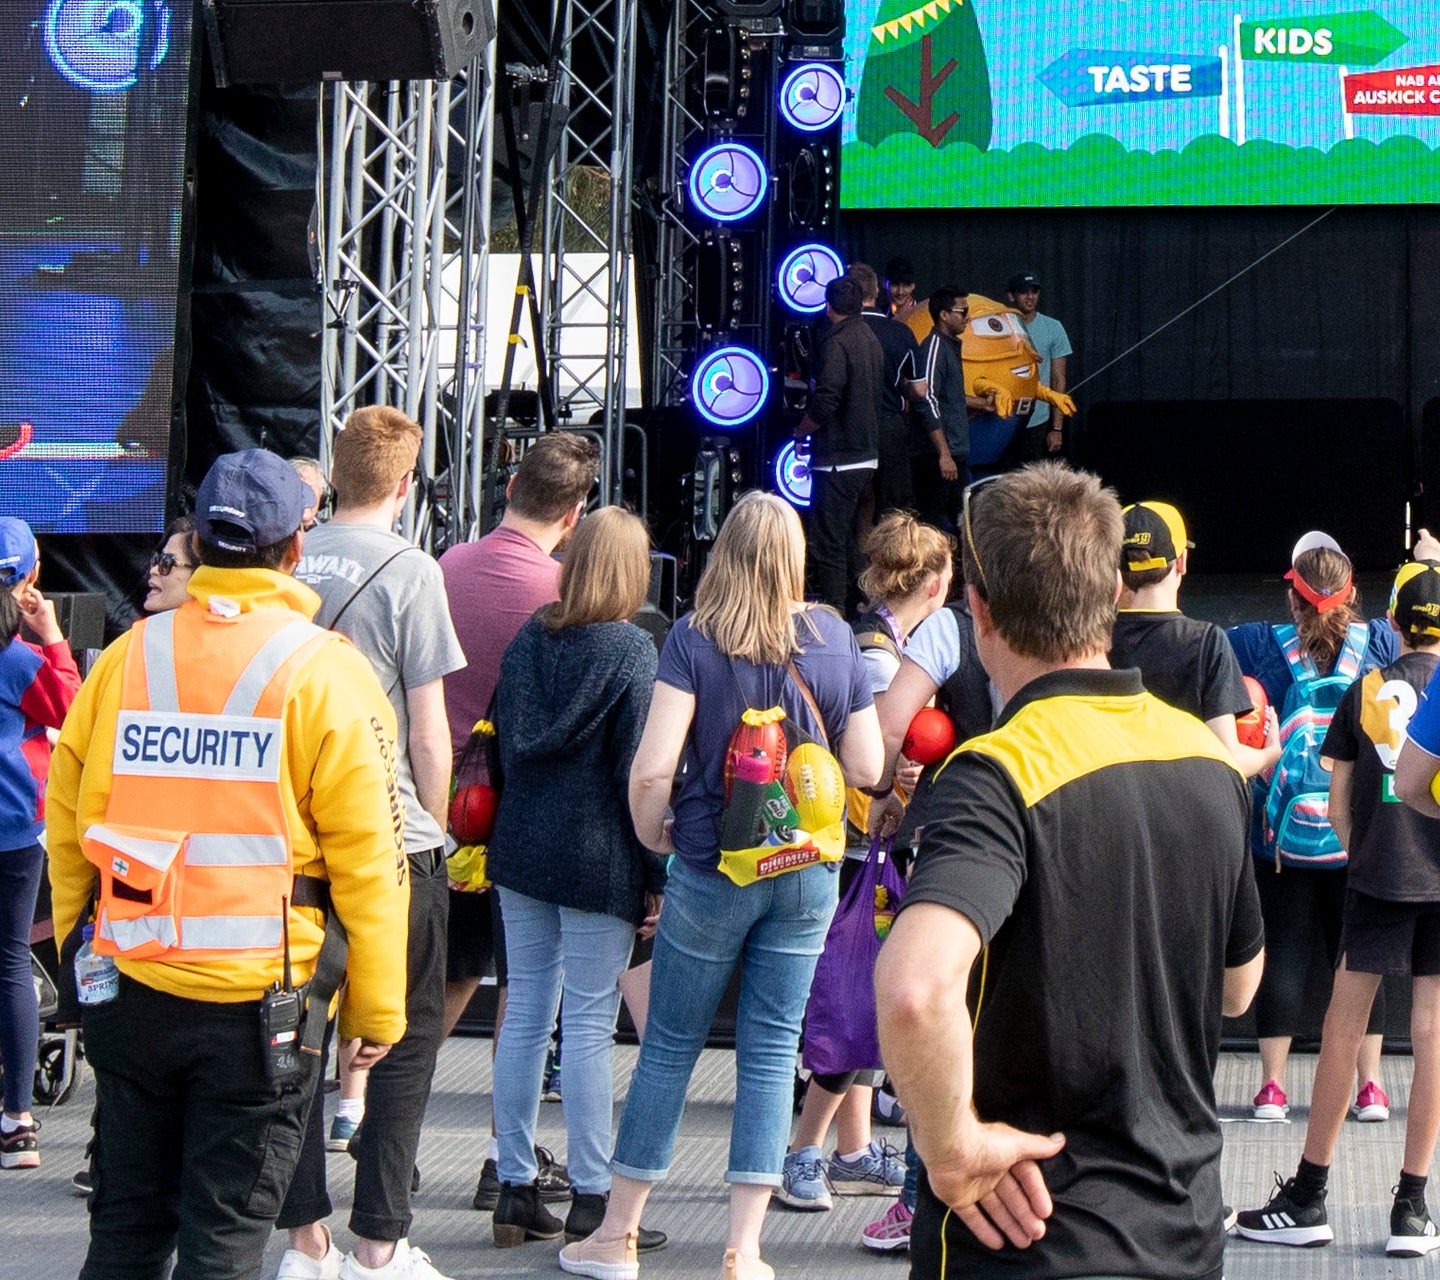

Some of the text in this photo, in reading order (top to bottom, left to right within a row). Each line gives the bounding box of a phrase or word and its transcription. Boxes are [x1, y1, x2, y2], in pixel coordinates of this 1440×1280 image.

[1253, 27, 1333, 56] KIDS
[1088, 64, 1192, 93] TASTE
[1395, 74, 1425, 86] NAB
[1353, 89, 1426, 105] AUSKICK
[1375, 680, 1418, 770] 3
[122, 723, 273, 768] SECURITY
[760, 850, 819, 872] CHEMIST
